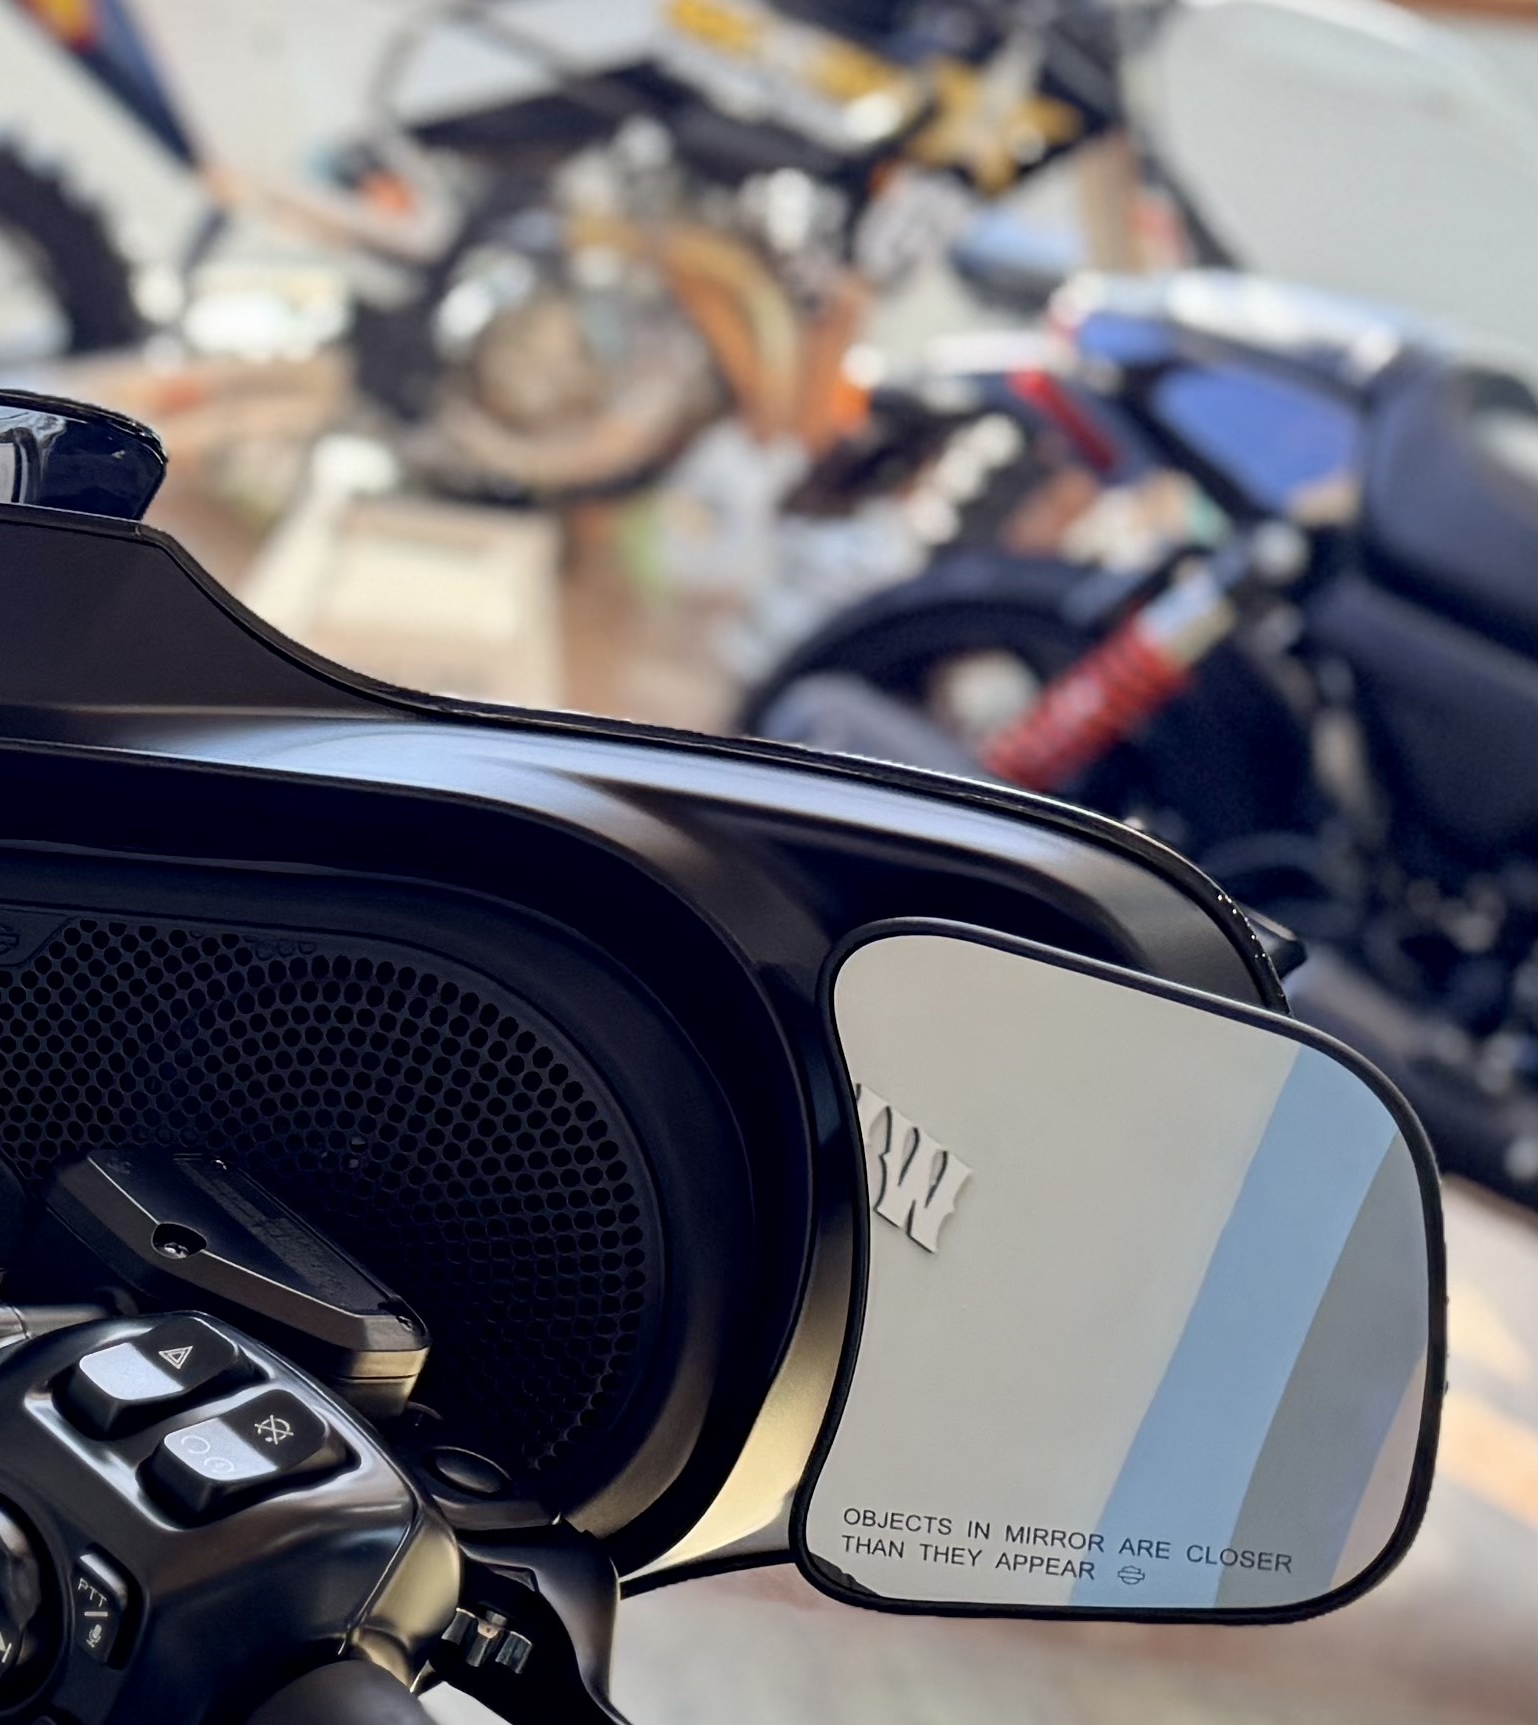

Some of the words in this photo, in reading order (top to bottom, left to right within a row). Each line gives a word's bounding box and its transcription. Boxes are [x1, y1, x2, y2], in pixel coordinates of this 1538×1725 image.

[841, 1535, 905, 1558] THAN
[919, 1544, 983, 1566] THEY
[994, 1552, 1096, 1581] APPEAR
[842, 1507, 953, 1537] OBJECTS
[967, 1520, 991, 1539] IN
[1003, 1525, 1105, 1552] MIRROR
[1118, 1536, 1171, 1560] ARE
[1186, 1544, 1293, 1574] CLOSER
[77, 1576, 108, 1608] PTT
